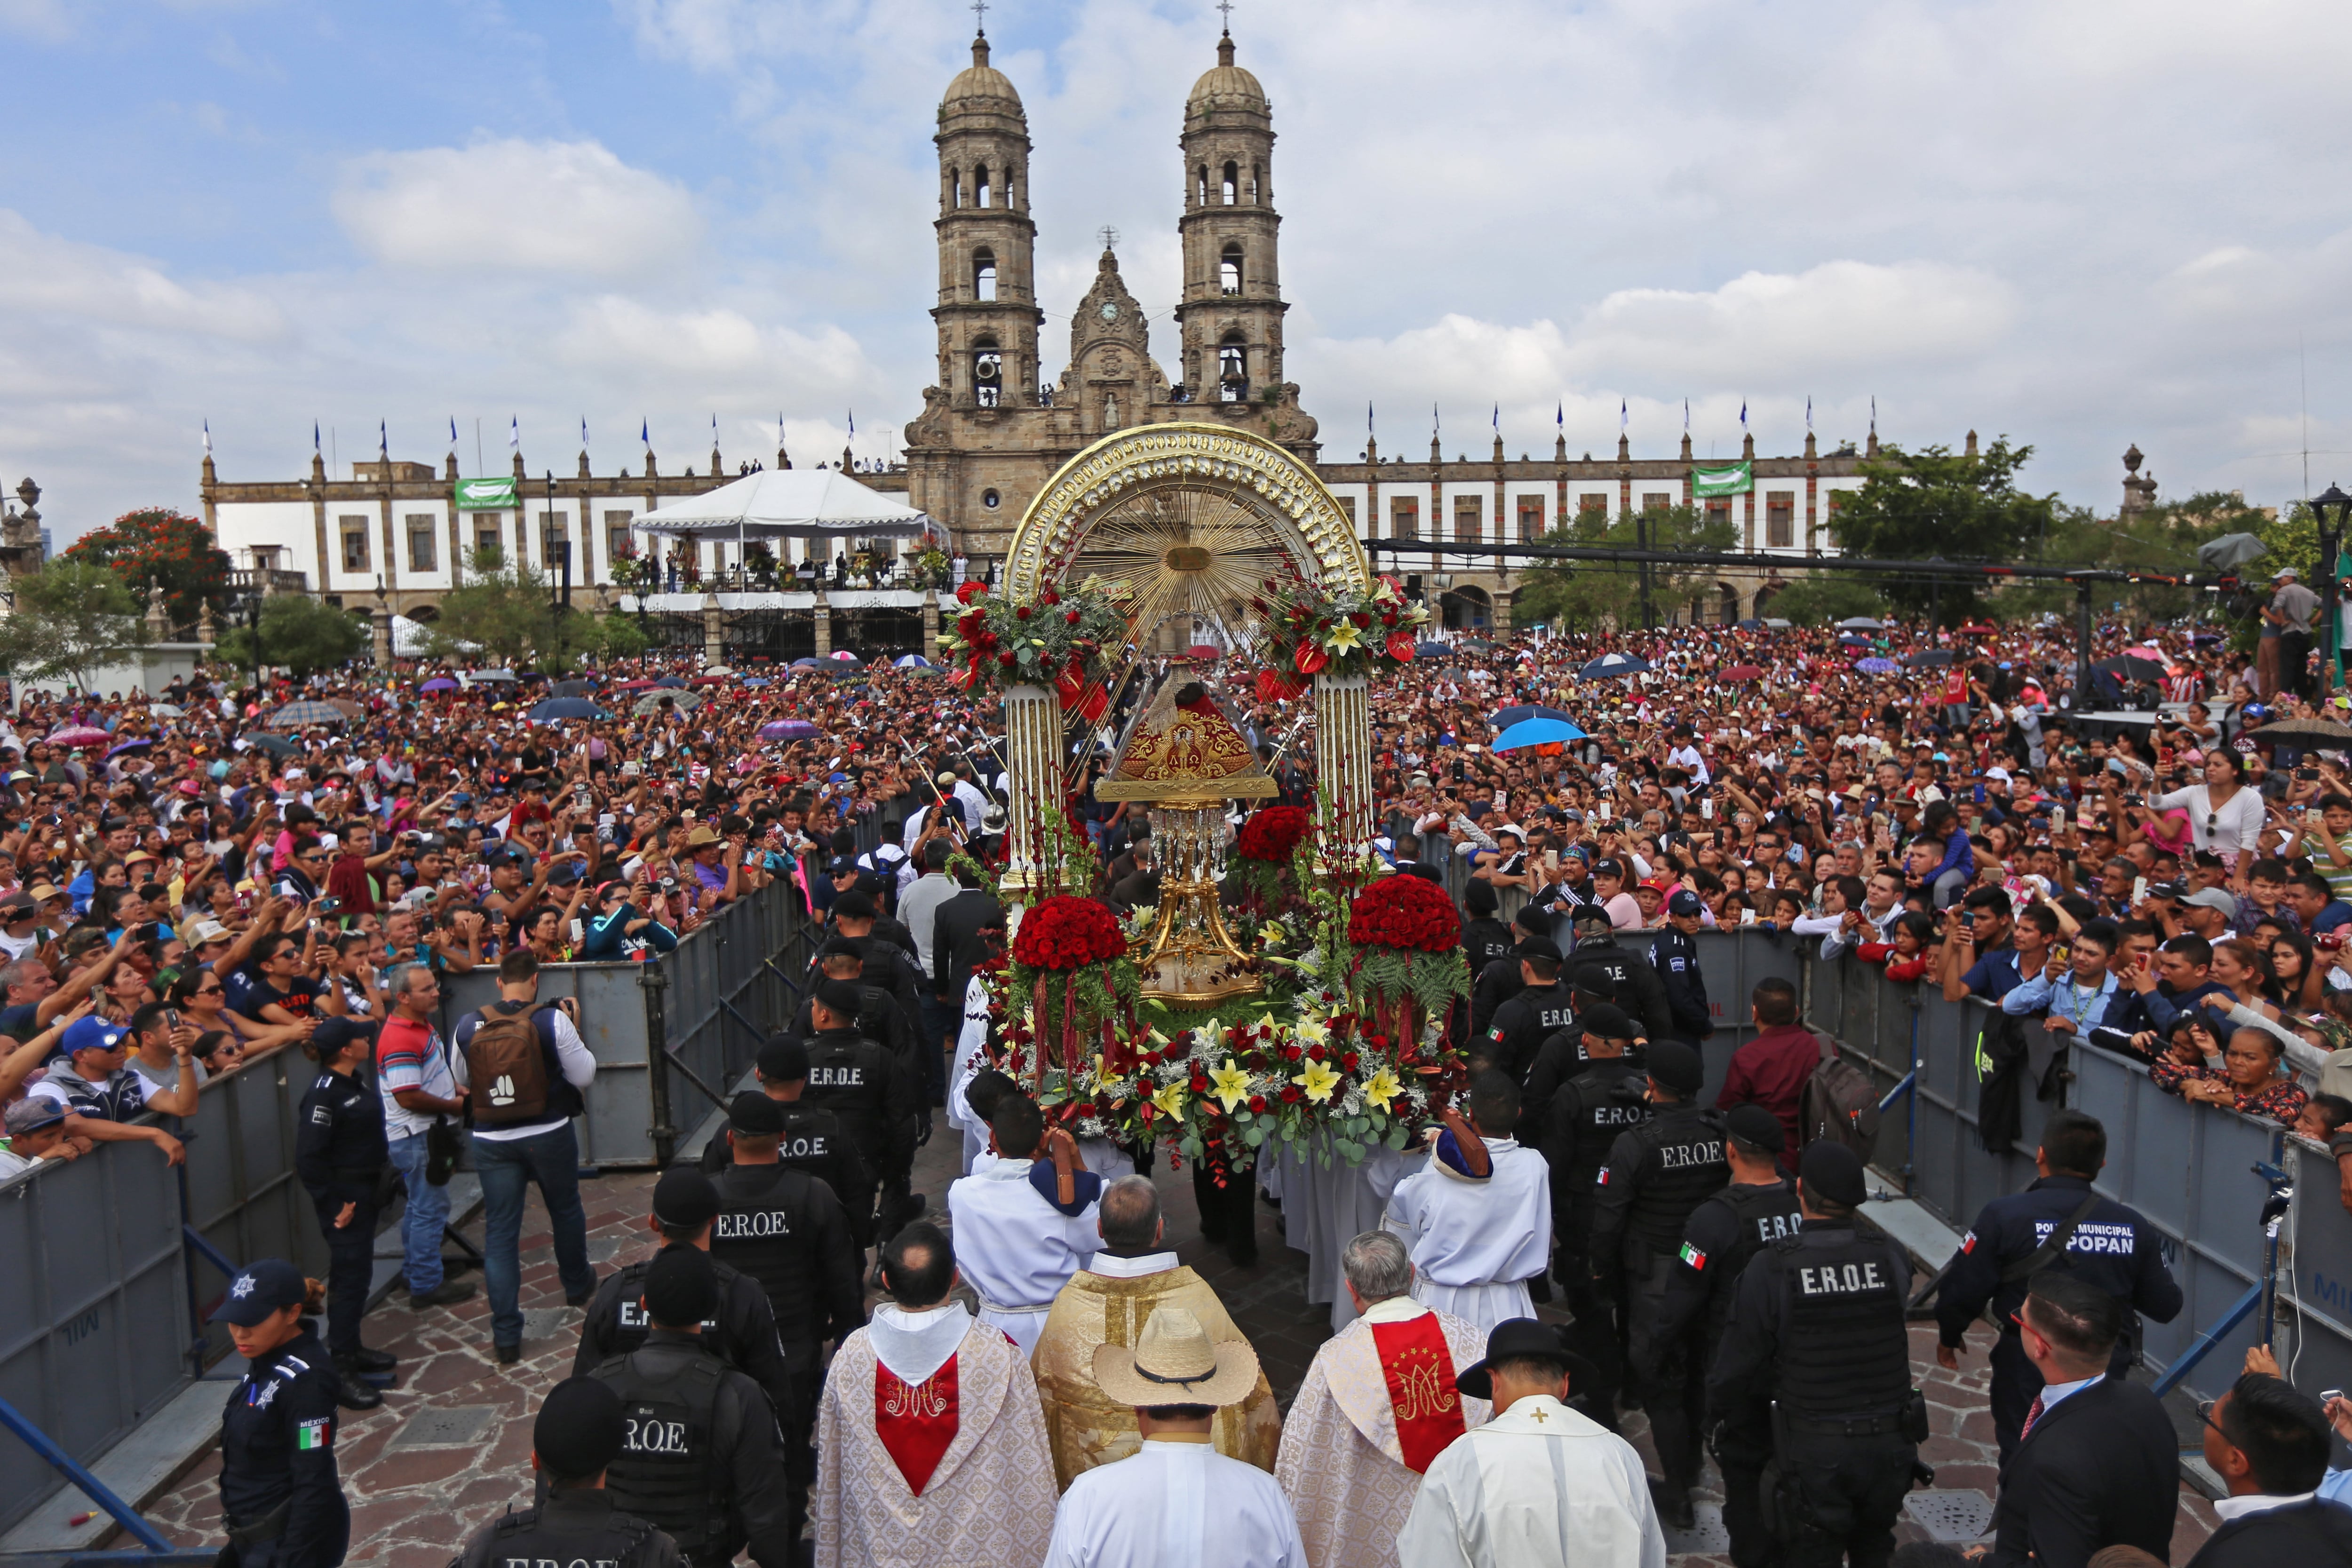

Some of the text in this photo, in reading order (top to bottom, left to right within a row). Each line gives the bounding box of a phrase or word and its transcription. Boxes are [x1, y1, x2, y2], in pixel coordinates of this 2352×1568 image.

[810, 1067, 864, 1085] E.R.O.E.
[1661, 1141, 1724, 1168] E.R.O.E.
[716, 1212, 789, 1237] E.R.O.E.
[2077, 1224, 2133, 1237] MUNICIPAL
[2036, 1235, 2133, 1253] ZPOPAN
[1801, 1262, 1885, 1294] E.R.O.E.
[300, 1417, 329, 1427] MÉXICO
